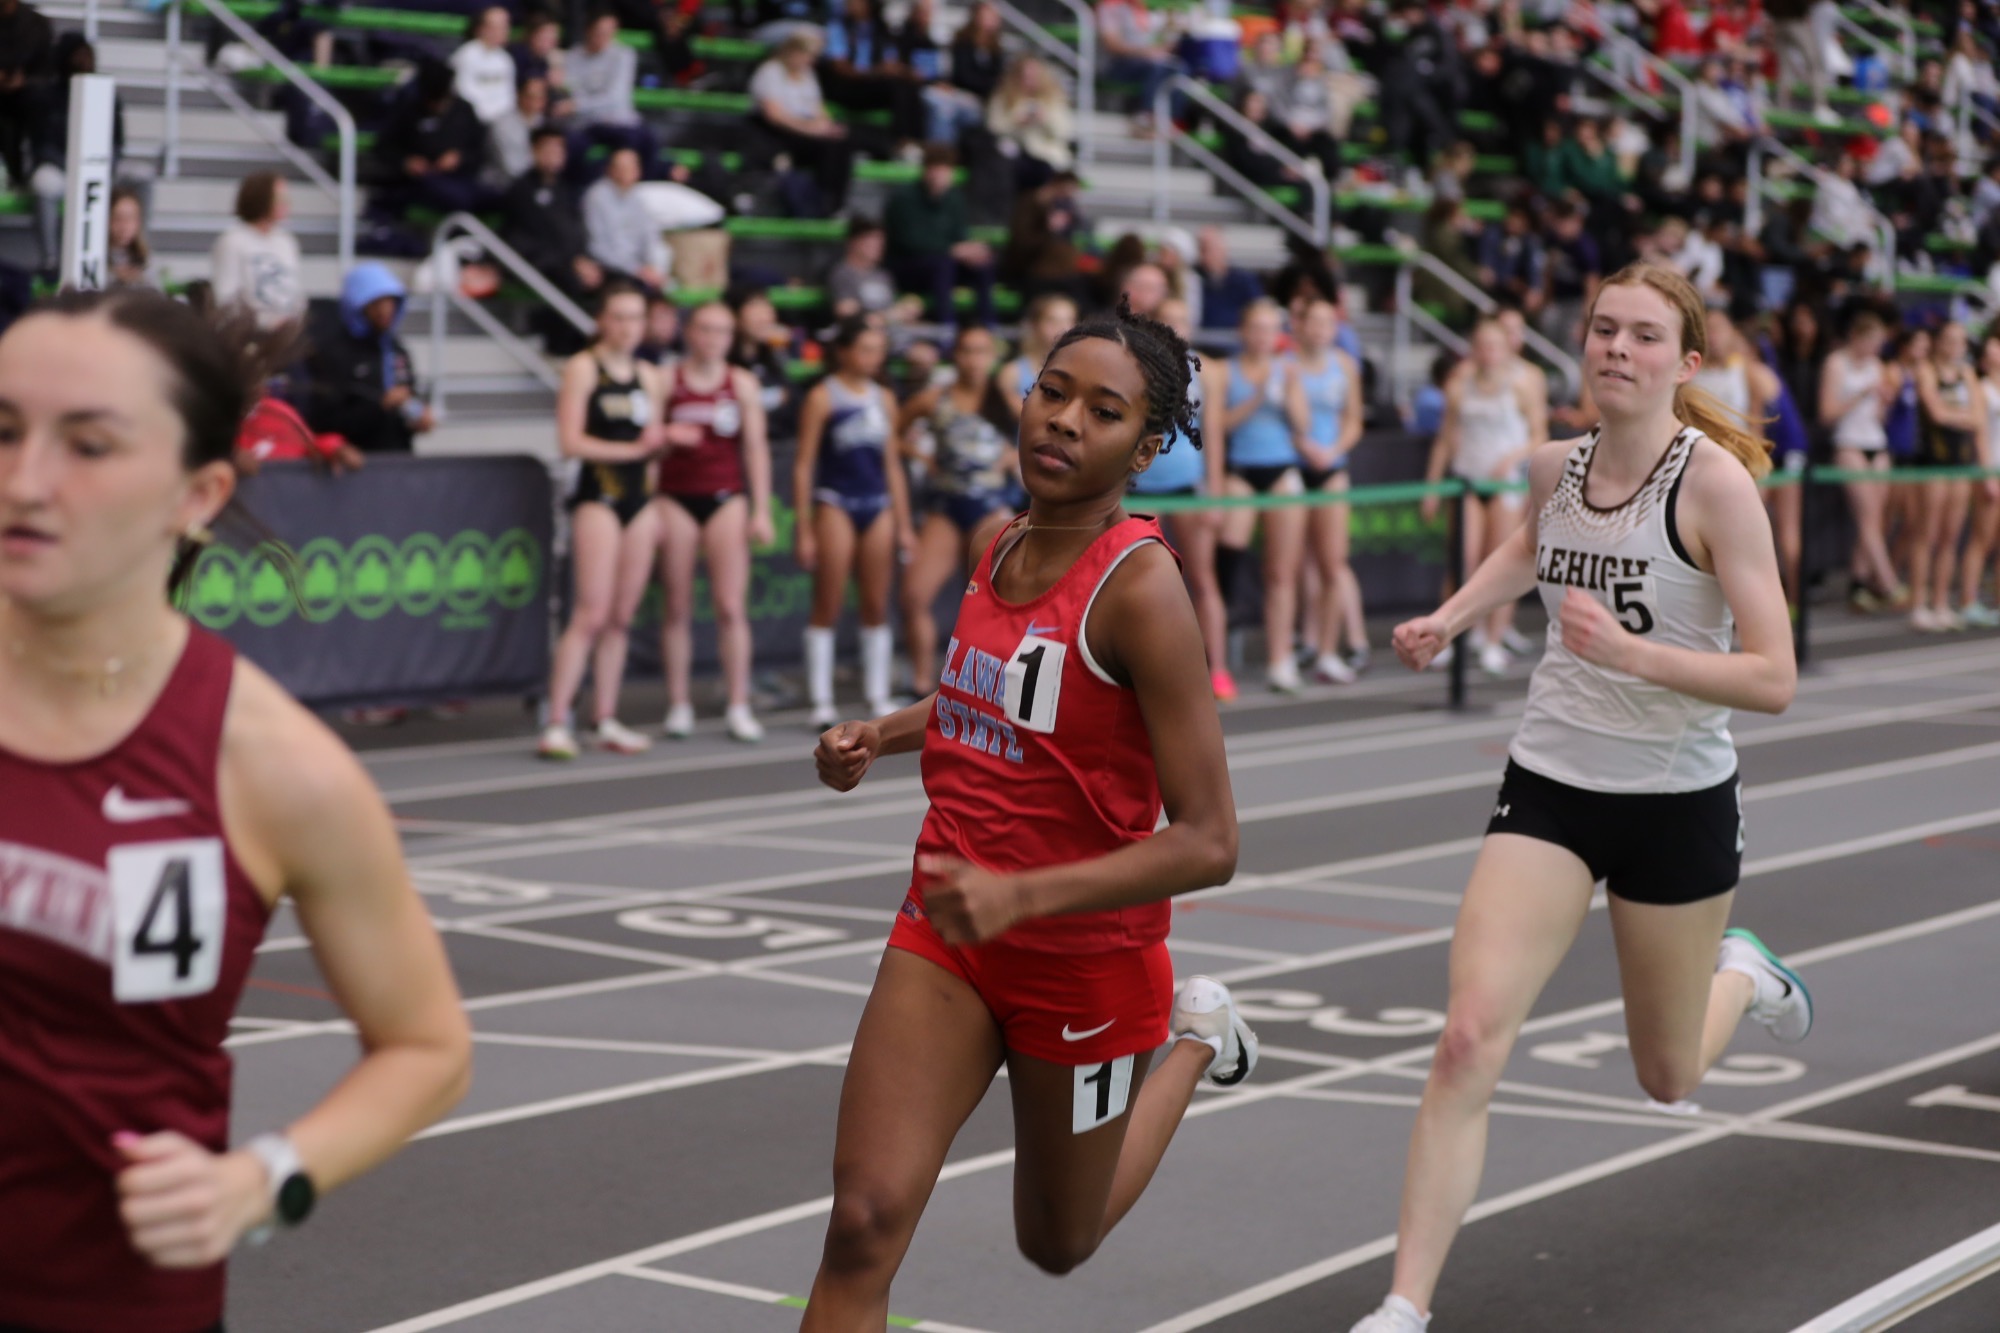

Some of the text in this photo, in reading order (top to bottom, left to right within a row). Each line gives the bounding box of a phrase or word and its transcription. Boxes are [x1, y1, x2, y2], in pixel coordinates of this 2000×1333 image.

[1537, 545, 1648, 590] LEHIGH
[1613, 582, 1653, 634] 5
[1017, 644, 1046, 722] 1
[937, 695, 1023, 764] STATE
[132, 857, 204, 980] 4
[1084, 1060, 1113, 1121] 1
